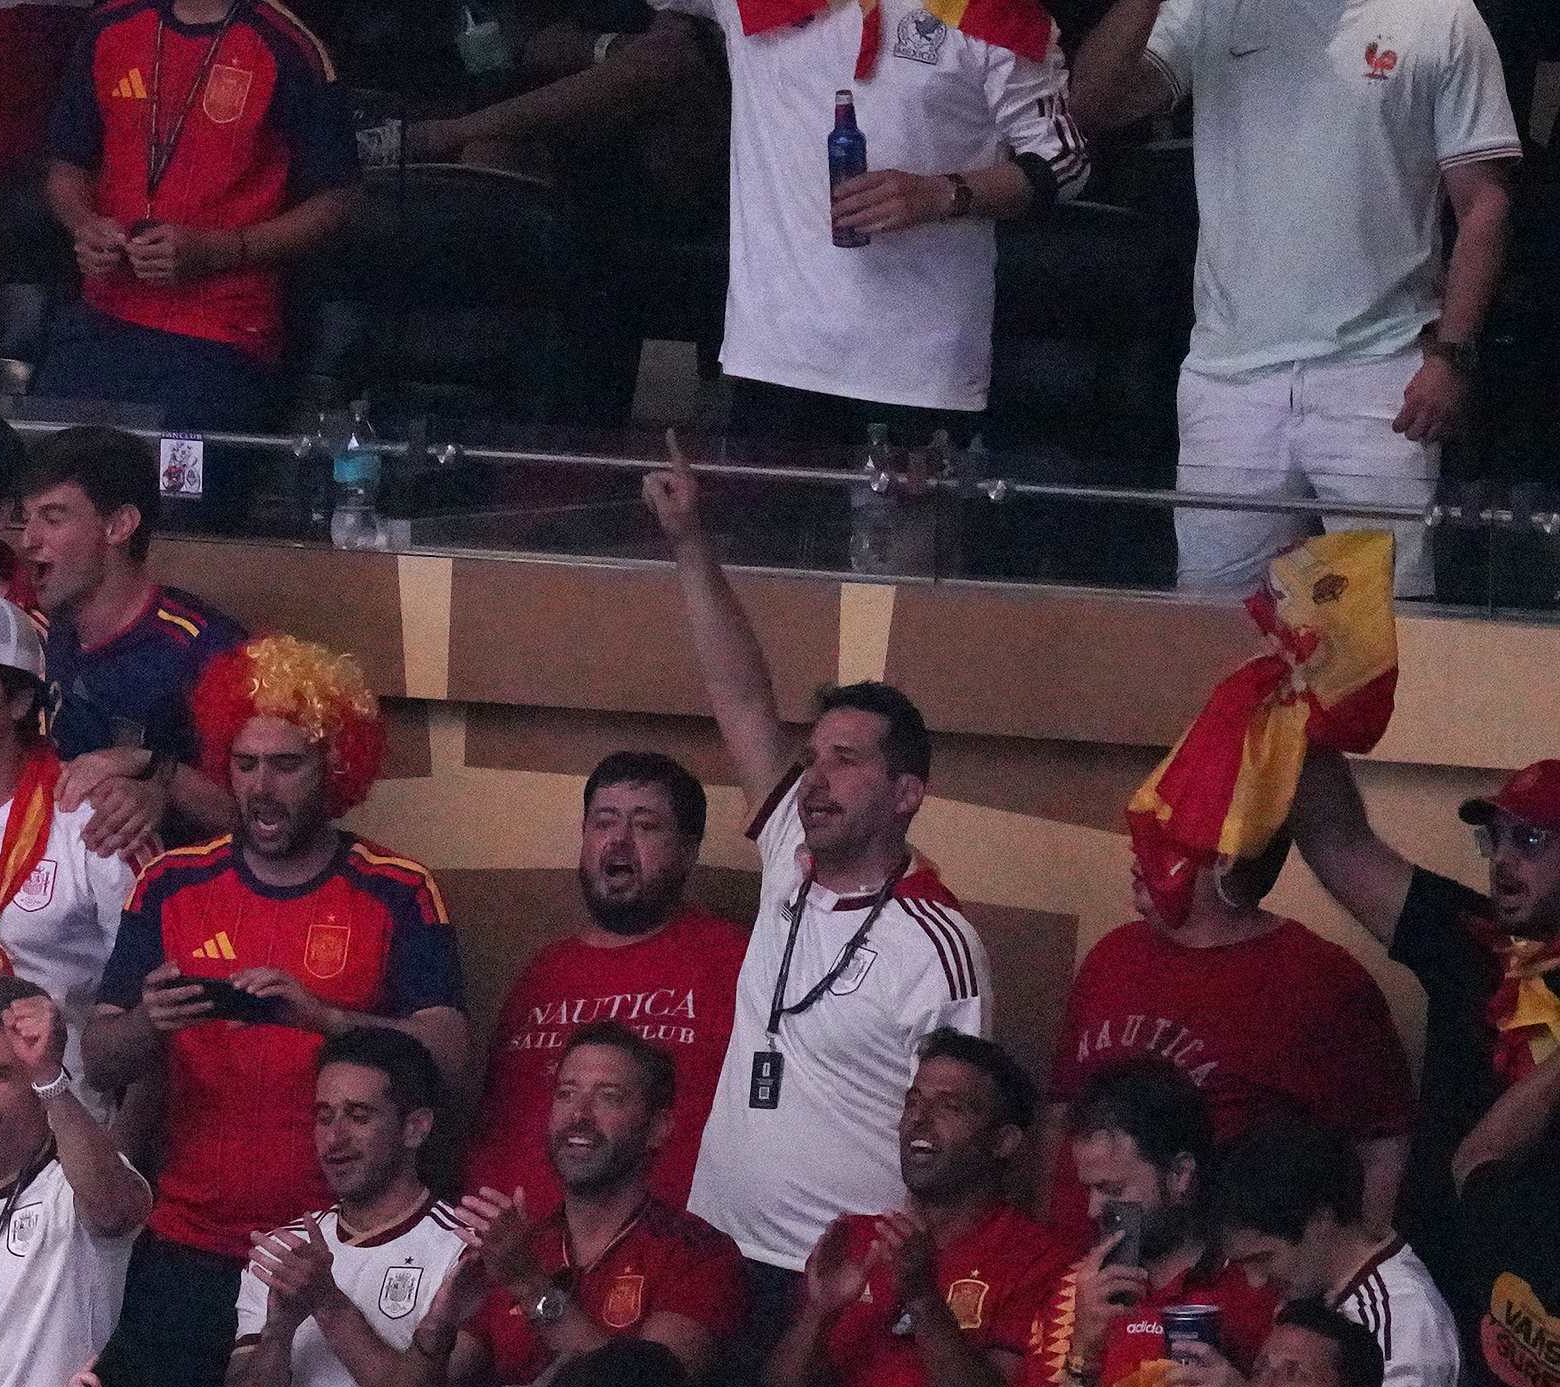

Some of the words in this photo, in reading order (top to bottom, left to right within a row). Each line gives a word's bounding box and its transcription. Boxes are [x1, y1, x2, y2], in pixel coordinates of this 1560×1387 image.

[532, 988, 698, 1028] NAUTICA
[1079, 1015, 1219, 1087] NAUTICA
[1126, 1320, 1165, 1335] adida
